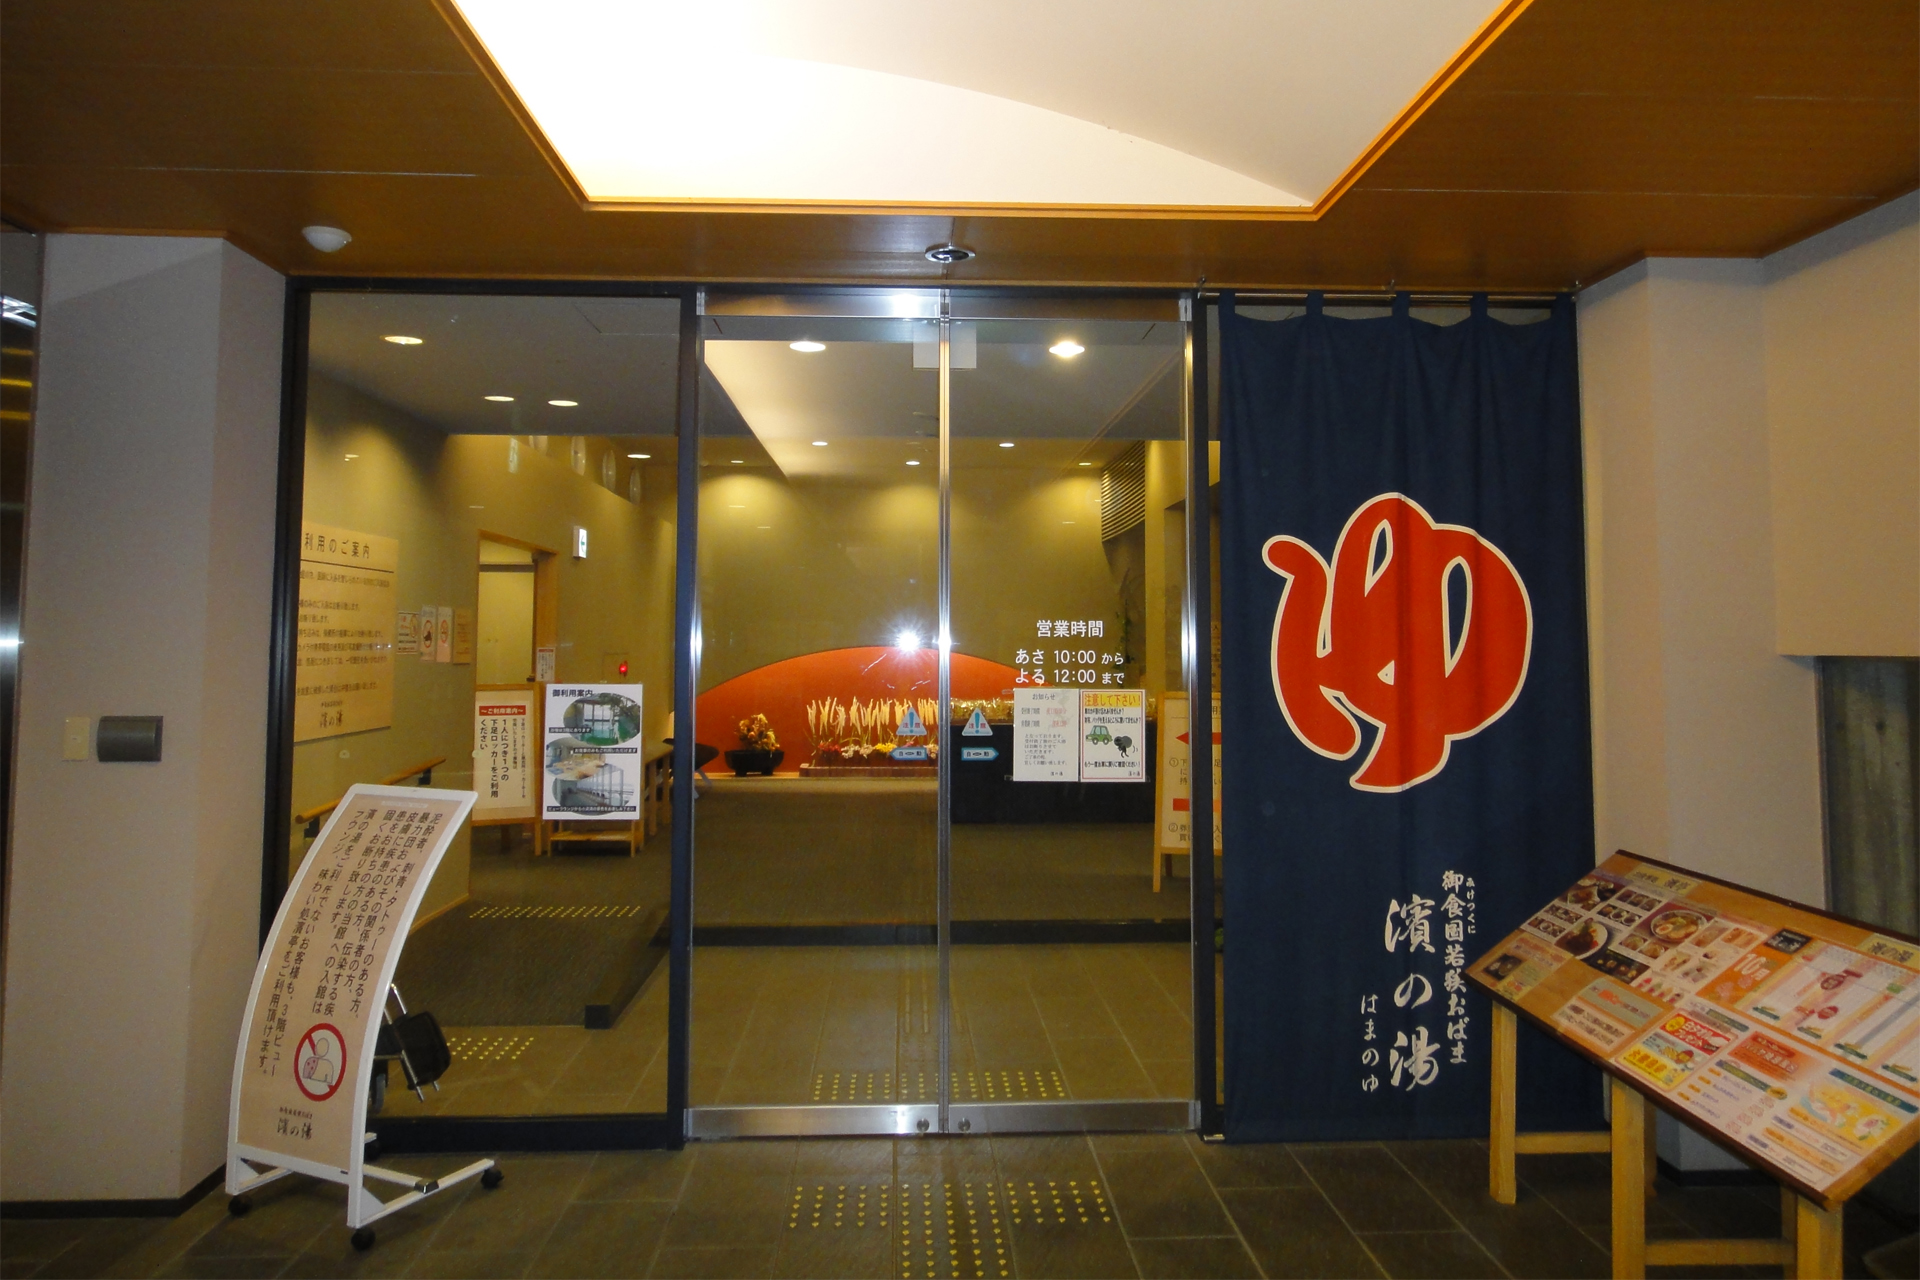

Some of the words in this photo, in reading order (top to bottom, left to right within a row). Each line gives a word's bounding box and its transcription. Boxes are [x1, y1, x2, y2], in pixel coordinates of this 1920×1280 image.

[305, 532, 370, 559] 利用のご案内
[1036, 620, 1104, 638] 営業時間
[1262, 492, 1533, 793] ゆ
[1015, 649, 1045, 665] あさ
[1053, 650, 1096, 665] 10:00
[1101, 653, 1124, 665] から
[1015, 668, 1045, 684] よる
[1053, 669, 1096, 684] 12:00
[1101, 672, 1125, 685] まで
[552, 688, 593, 698] 御利用案内
[1032, 693, 1056, 701] お知らせ
[480, 719, 488, 750] ください
[490, 719, 499, 799] 下足ロッカーをご利用
[501, 719, 509, 782] 1人につき1つの
[1384, 893, 1441, 1092] 濱の湯
[1360, 994, 1380, 1093] はまのゆ
